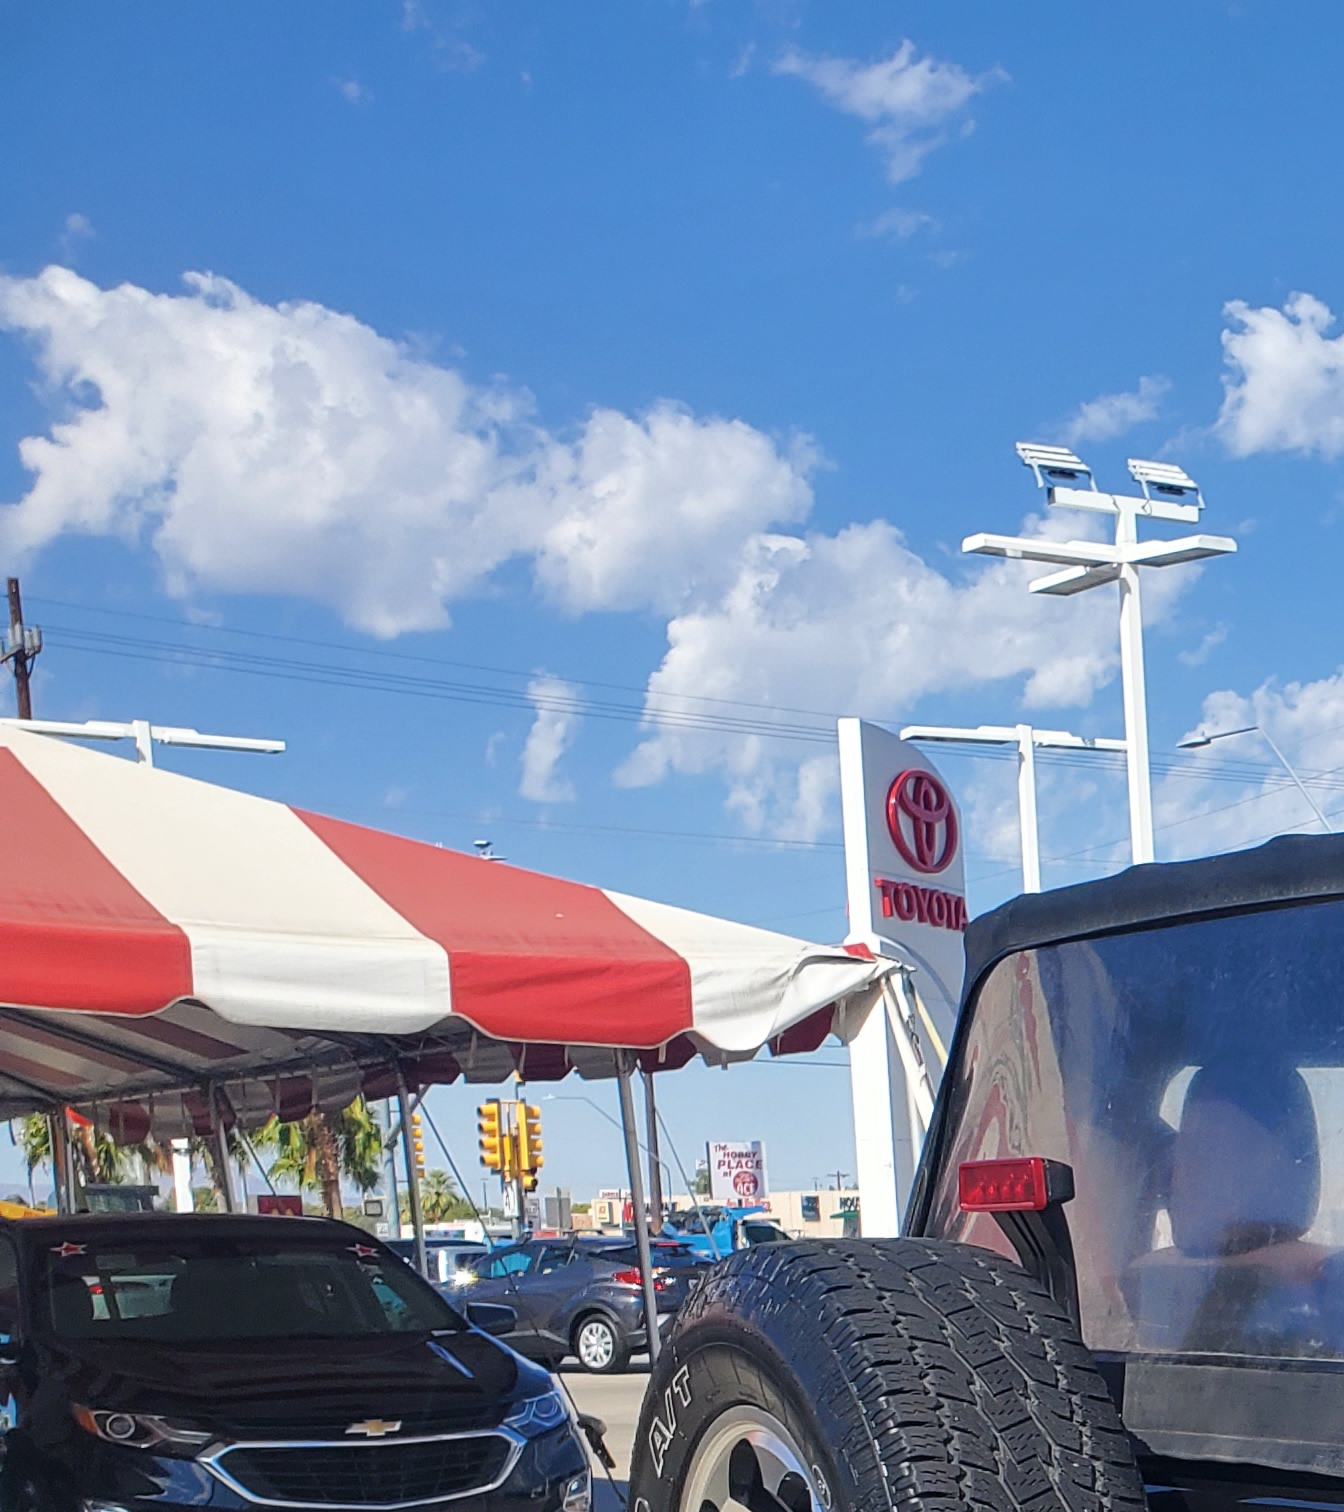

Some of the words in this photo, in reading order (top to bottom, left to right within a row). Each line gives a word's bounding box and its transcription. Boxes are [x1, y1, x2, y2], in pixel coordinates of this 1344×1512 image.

[875, 876, 968, 932] TOYOTA
[717, 1159, 763, 1170] PLACE
[648, 1363, 692, 1478] A/T
